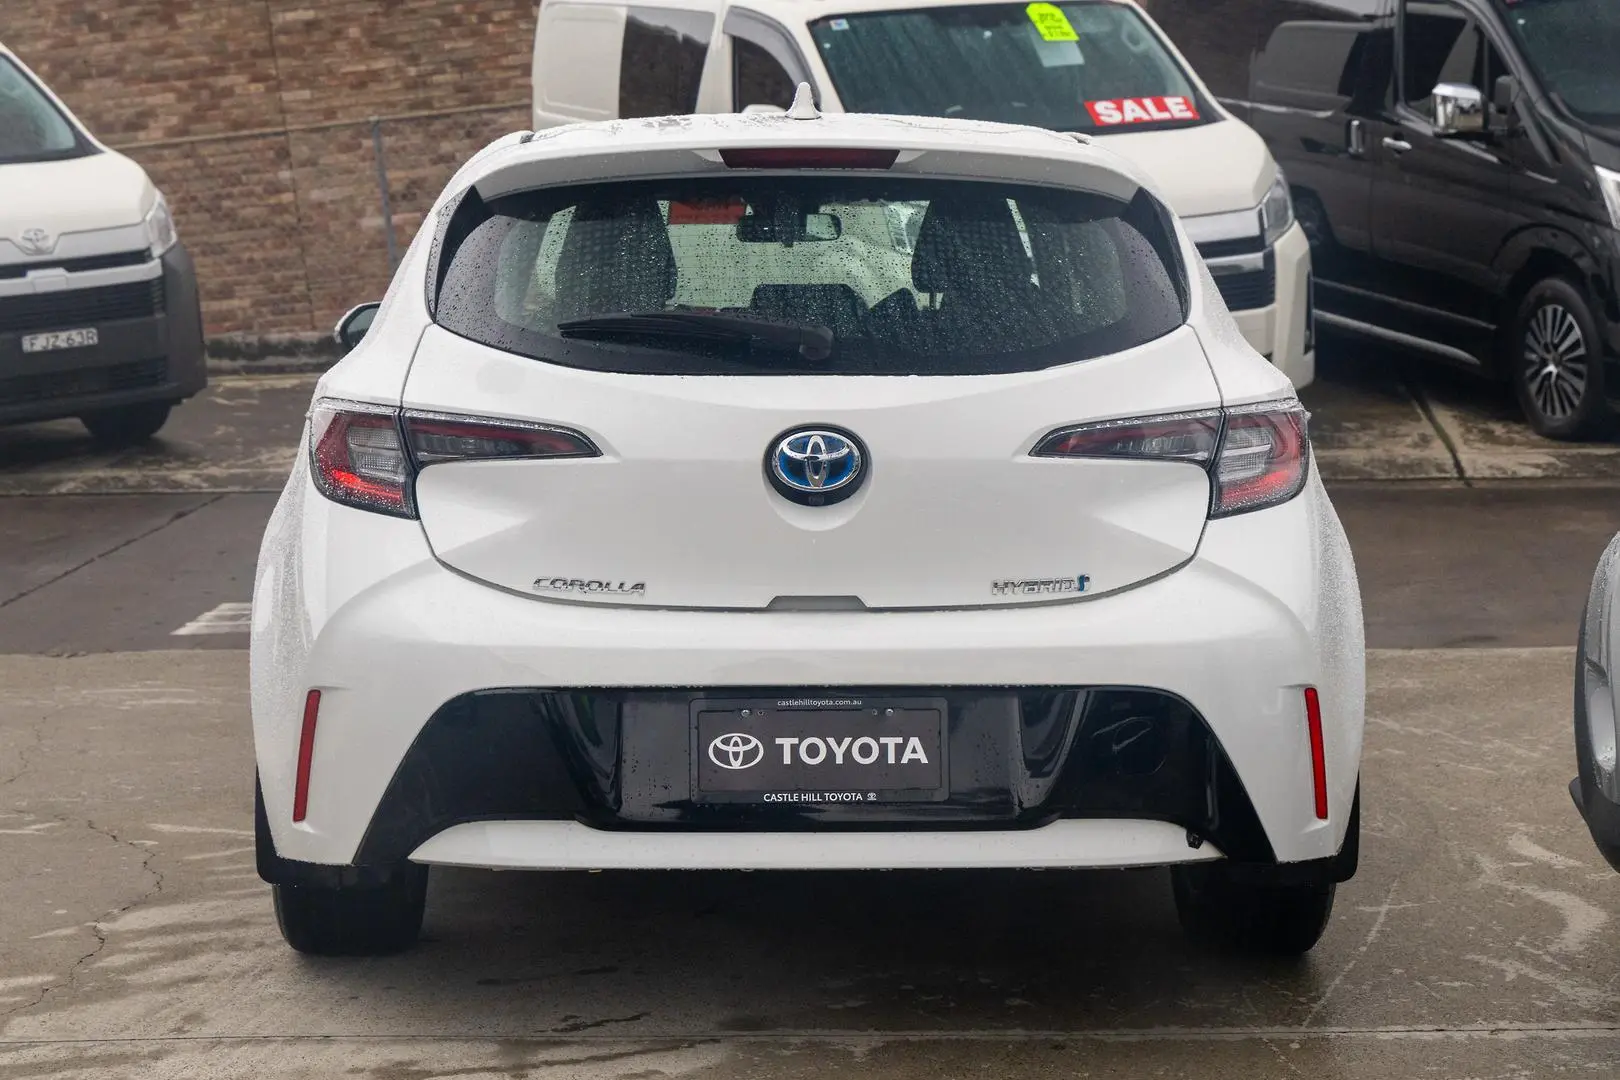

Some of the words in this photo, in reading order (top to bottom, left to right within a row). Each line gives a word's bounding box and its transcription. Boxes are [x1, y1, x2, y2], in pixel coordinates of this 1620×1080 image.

[1094, 97, 1193, 124] SALE
[533, 577, 646, 596] COROLLA
[992, 577, 1076, 596] HYBRID
[777, 698, 862, 707] castlehilltoyota.com.au
[775, 736, 929, 765] TOYOTA
[763, 793, 799, 802] CASTLE
[801, 793, 822, 802] HILL
[824, 792, 863, 801] TOYOTA
